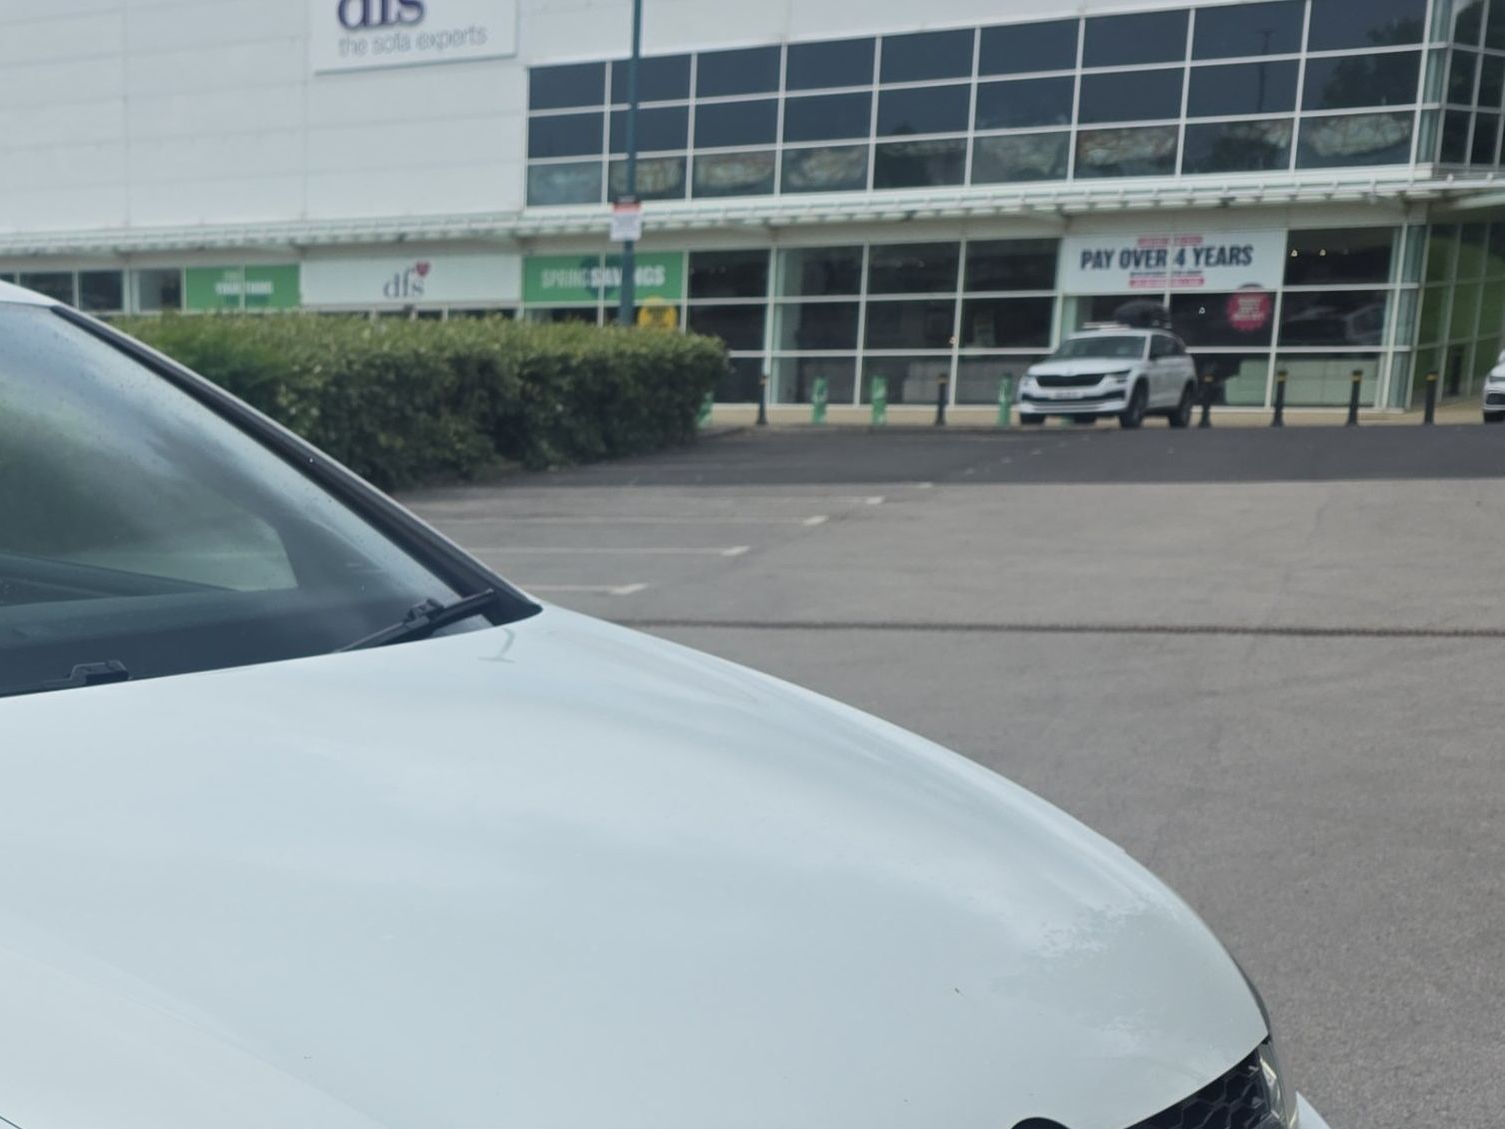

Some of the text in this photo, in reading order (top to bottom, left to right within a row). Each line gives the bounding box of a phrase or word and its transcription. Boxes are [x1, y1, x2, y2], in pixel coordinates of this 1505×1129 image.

[339, 25, 488, 57] the sofa experts
[1079, 244, 1254, 270] PAY OVER 4 YEARS
[383, 265, 425, 299] dfs
